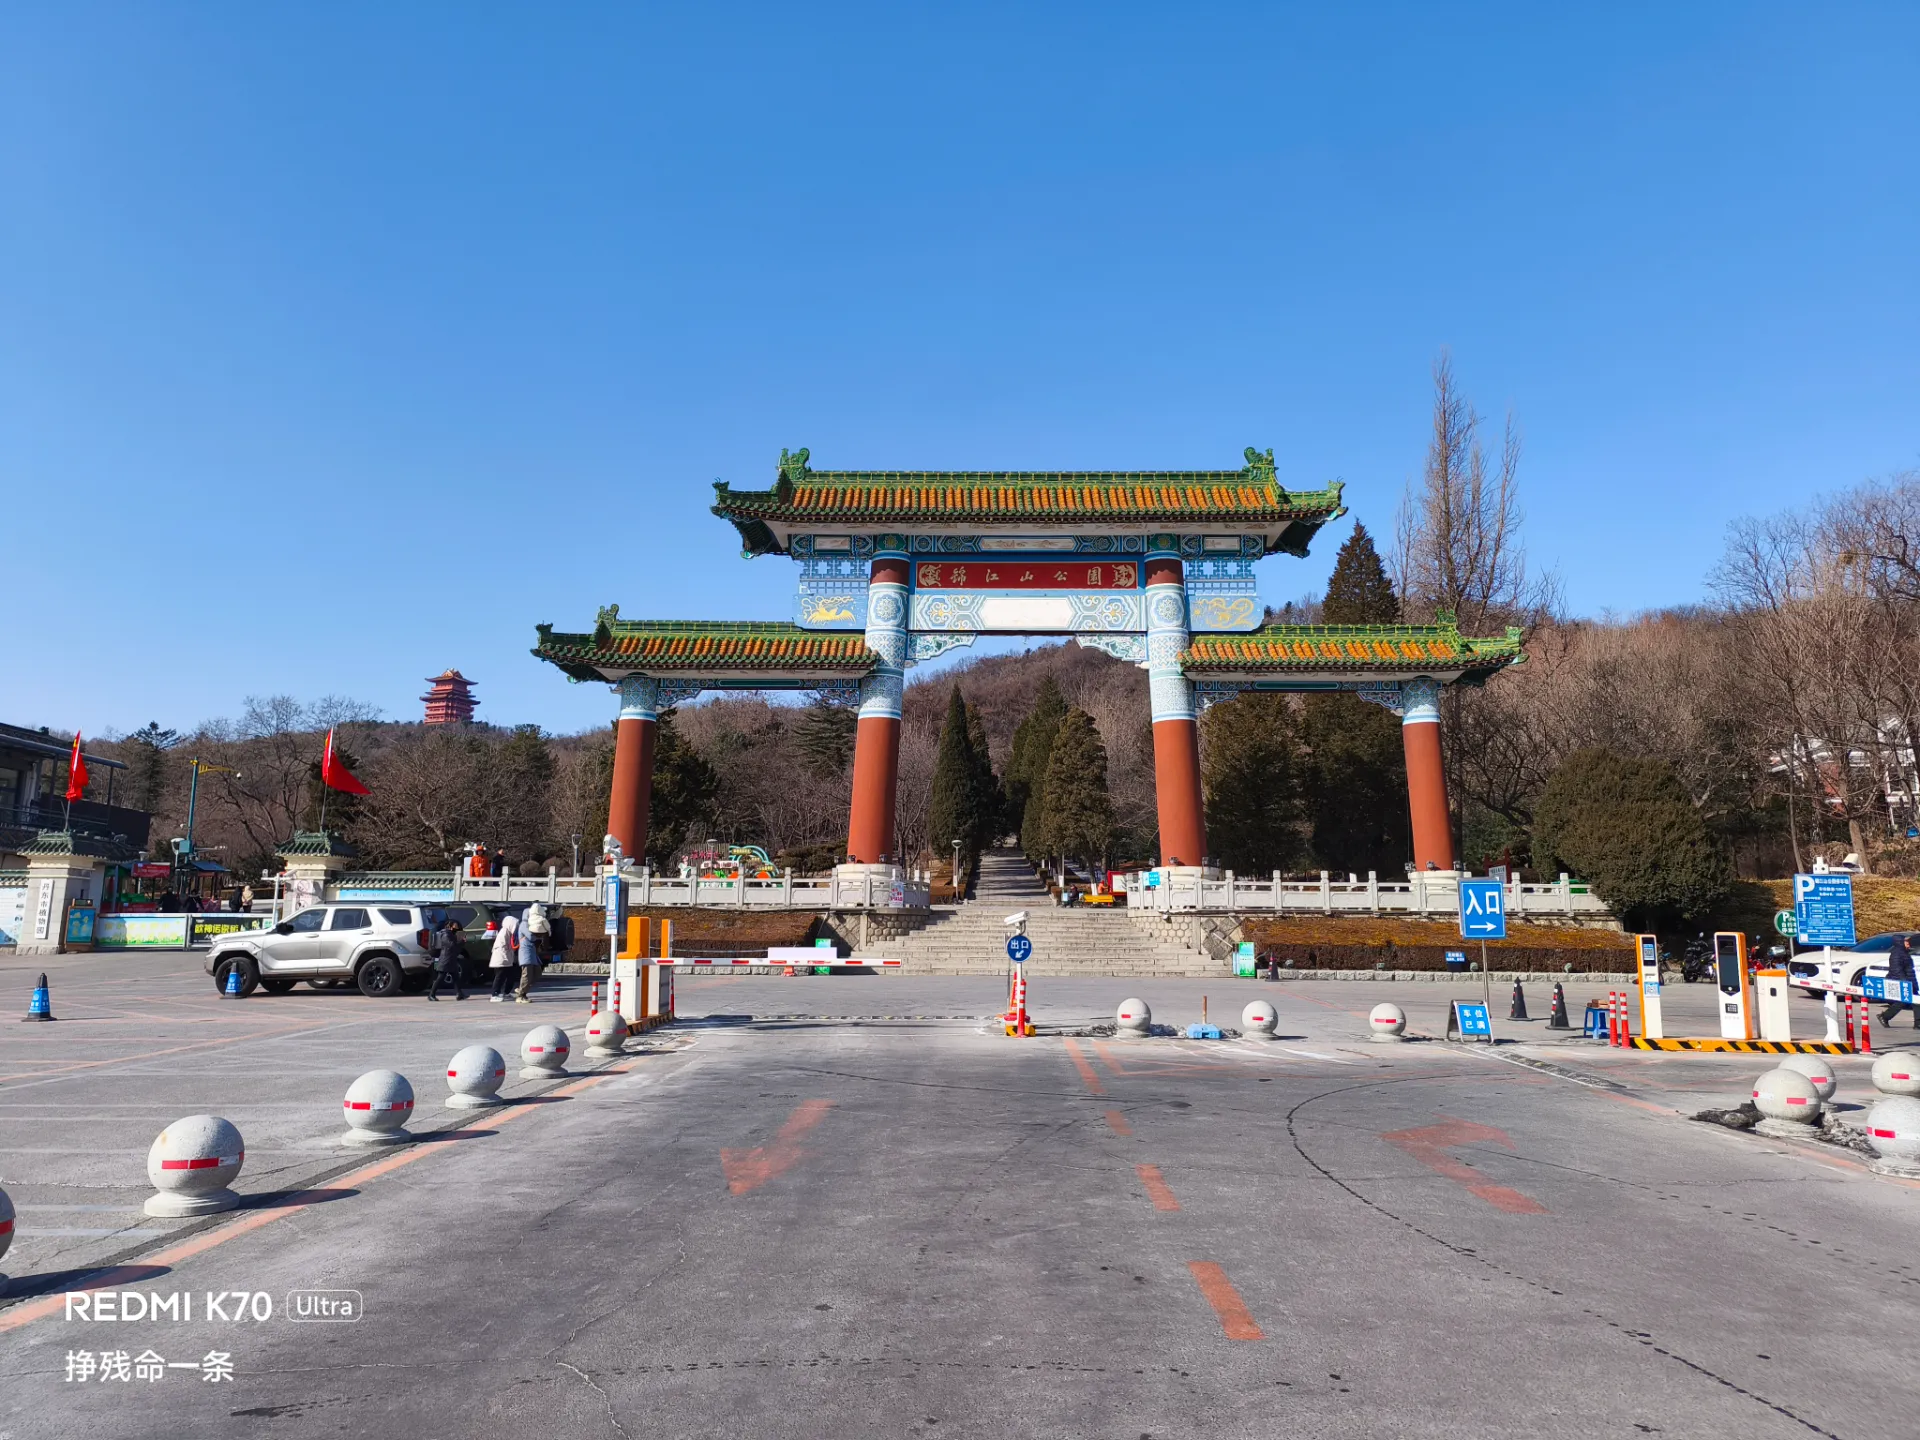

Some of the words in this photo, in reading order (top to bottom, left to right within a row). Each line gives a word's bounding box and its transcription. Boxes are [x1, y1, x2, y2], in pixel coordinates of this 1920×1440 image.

[1797, 876, 1815, 901] P
[1466, 888, 1500, 915] 入口
[1011, 939, 1029, 949] 出口
[1865, 978, 1874, 996] 入口
[1463, 1009, 1483, 1018] 车位
[1465, 1020, 1486, 1030] 已满
